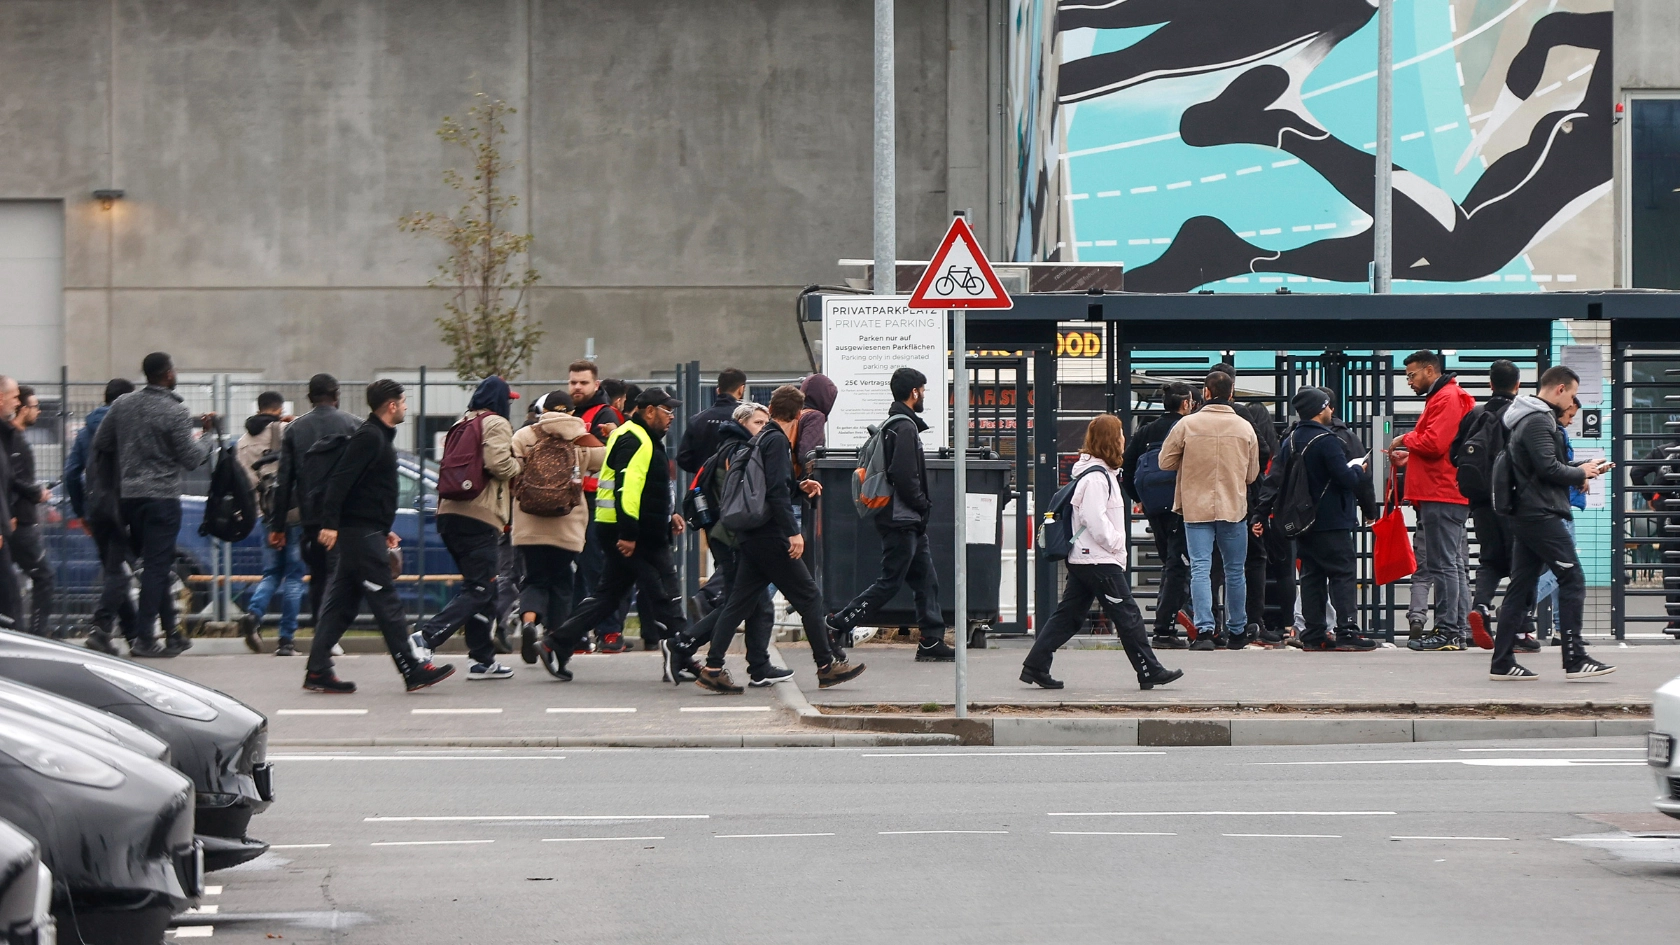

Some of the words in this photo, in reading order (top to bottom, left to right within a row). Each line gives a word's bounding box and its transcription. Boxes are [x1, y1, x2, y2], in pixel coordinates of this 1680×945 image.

[836, 319, 881, 328] PRIVATE
[885, 318, 935, 328] PARKING
[892, 353, 930, 361] designated
[860, 379, 892, 387] Vertragss
